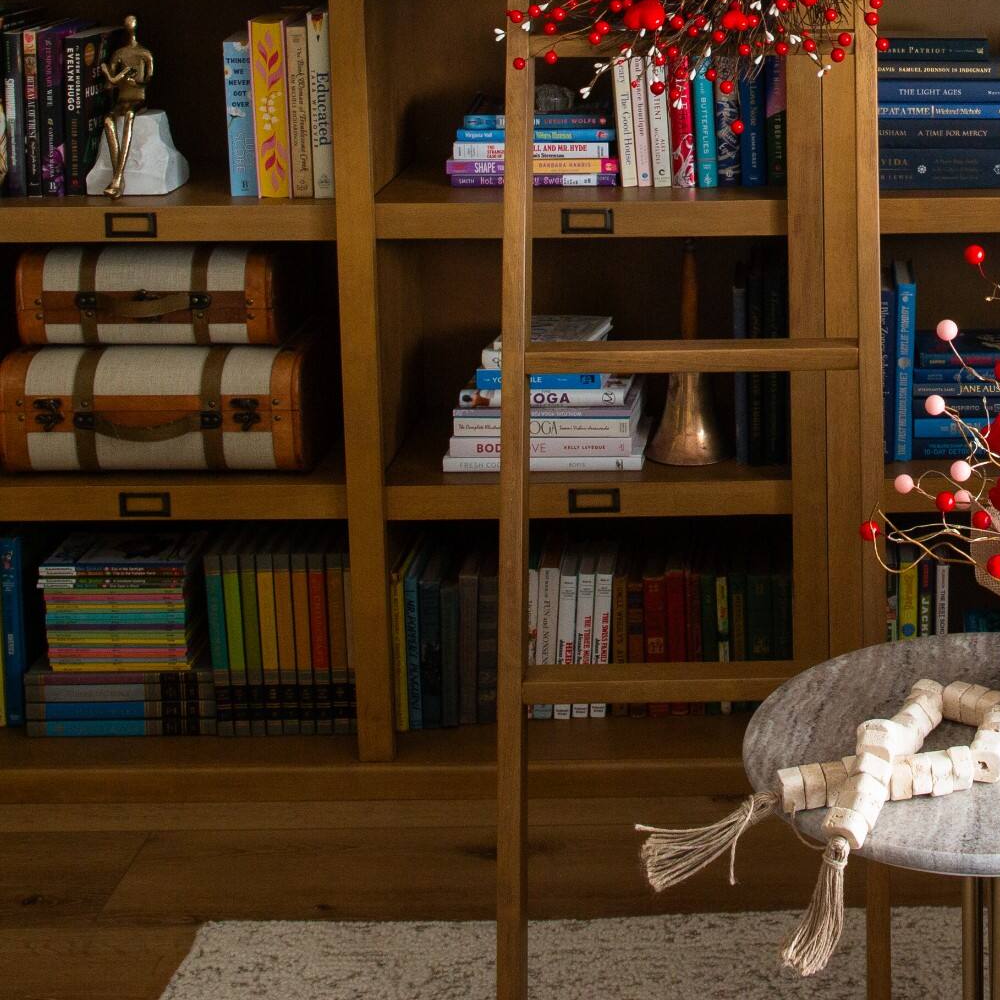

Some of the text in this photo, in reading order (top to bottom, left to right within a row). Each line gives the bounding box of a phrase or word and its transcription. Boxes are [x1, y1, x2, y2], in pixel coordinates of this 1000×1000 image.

[67, 47, 75, 111] EVELYN HUGO
[316, 72, 331, 146] Educated
[890, 107, 931, 115] AT TIME
[620, 94, 632, 166] The Good House
[700, 97, 710, 154] BUTTERFLIES
[474, 162, 496, 173] SHAPE
[960, 385, 981, 393] JANE
[476, 443, 501, 453] BOD
[543, 600, 551, 616] FUN
[583, 616, 592, 648] THE THREE
[601, 625, 609, 642] SWISS
[565, 643, 573, 664] HEID
